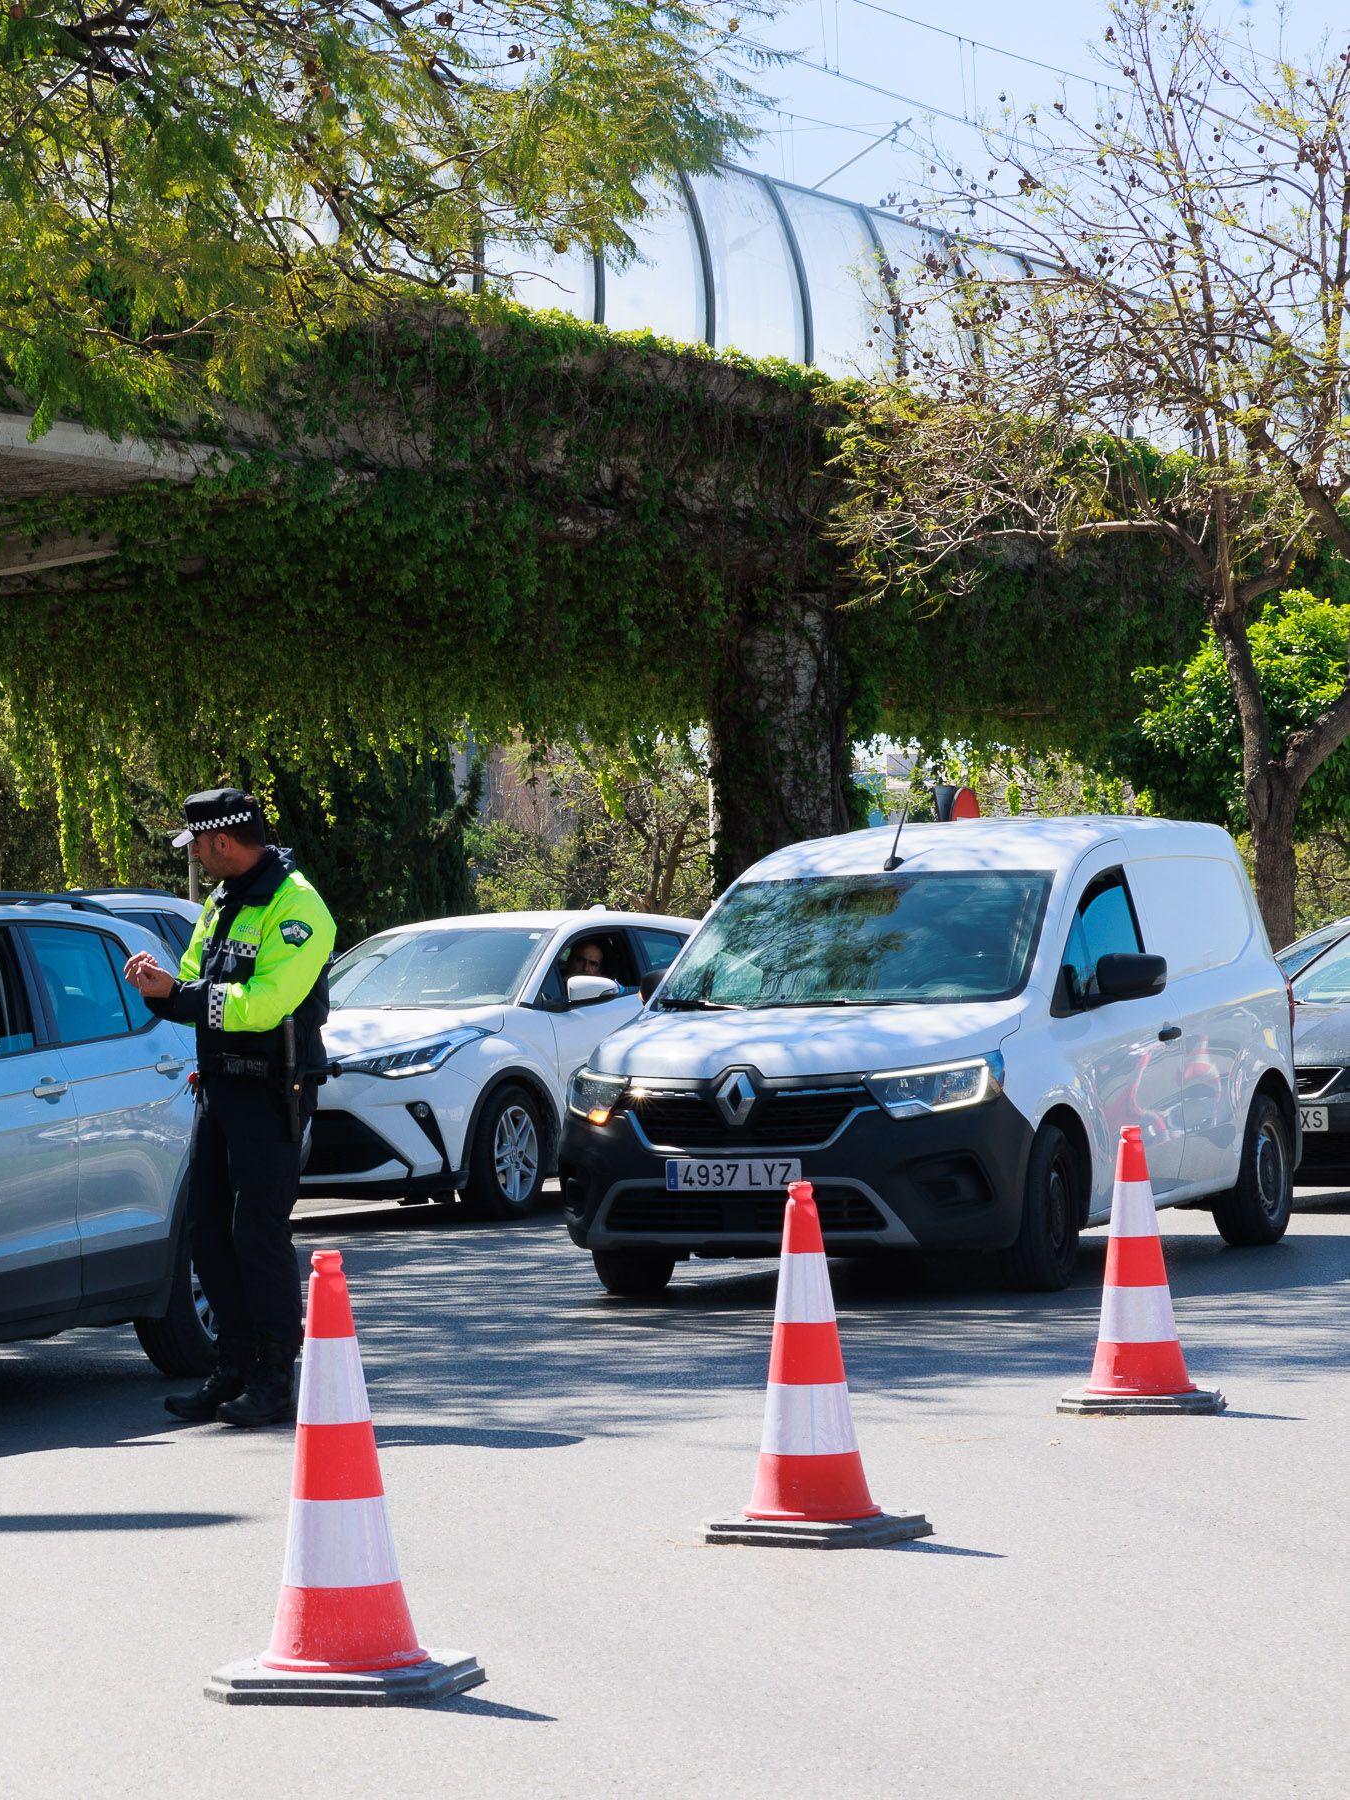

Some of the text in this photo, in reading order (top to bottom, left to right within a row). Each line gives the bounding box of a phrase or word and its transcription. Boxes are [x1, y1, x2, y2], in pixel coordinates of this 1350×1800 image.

[1300, 1110, 1323, 1128] XS
[683, 1164, 739, 1186] 4937
[748, 1163, 792, 1186] LYZ
